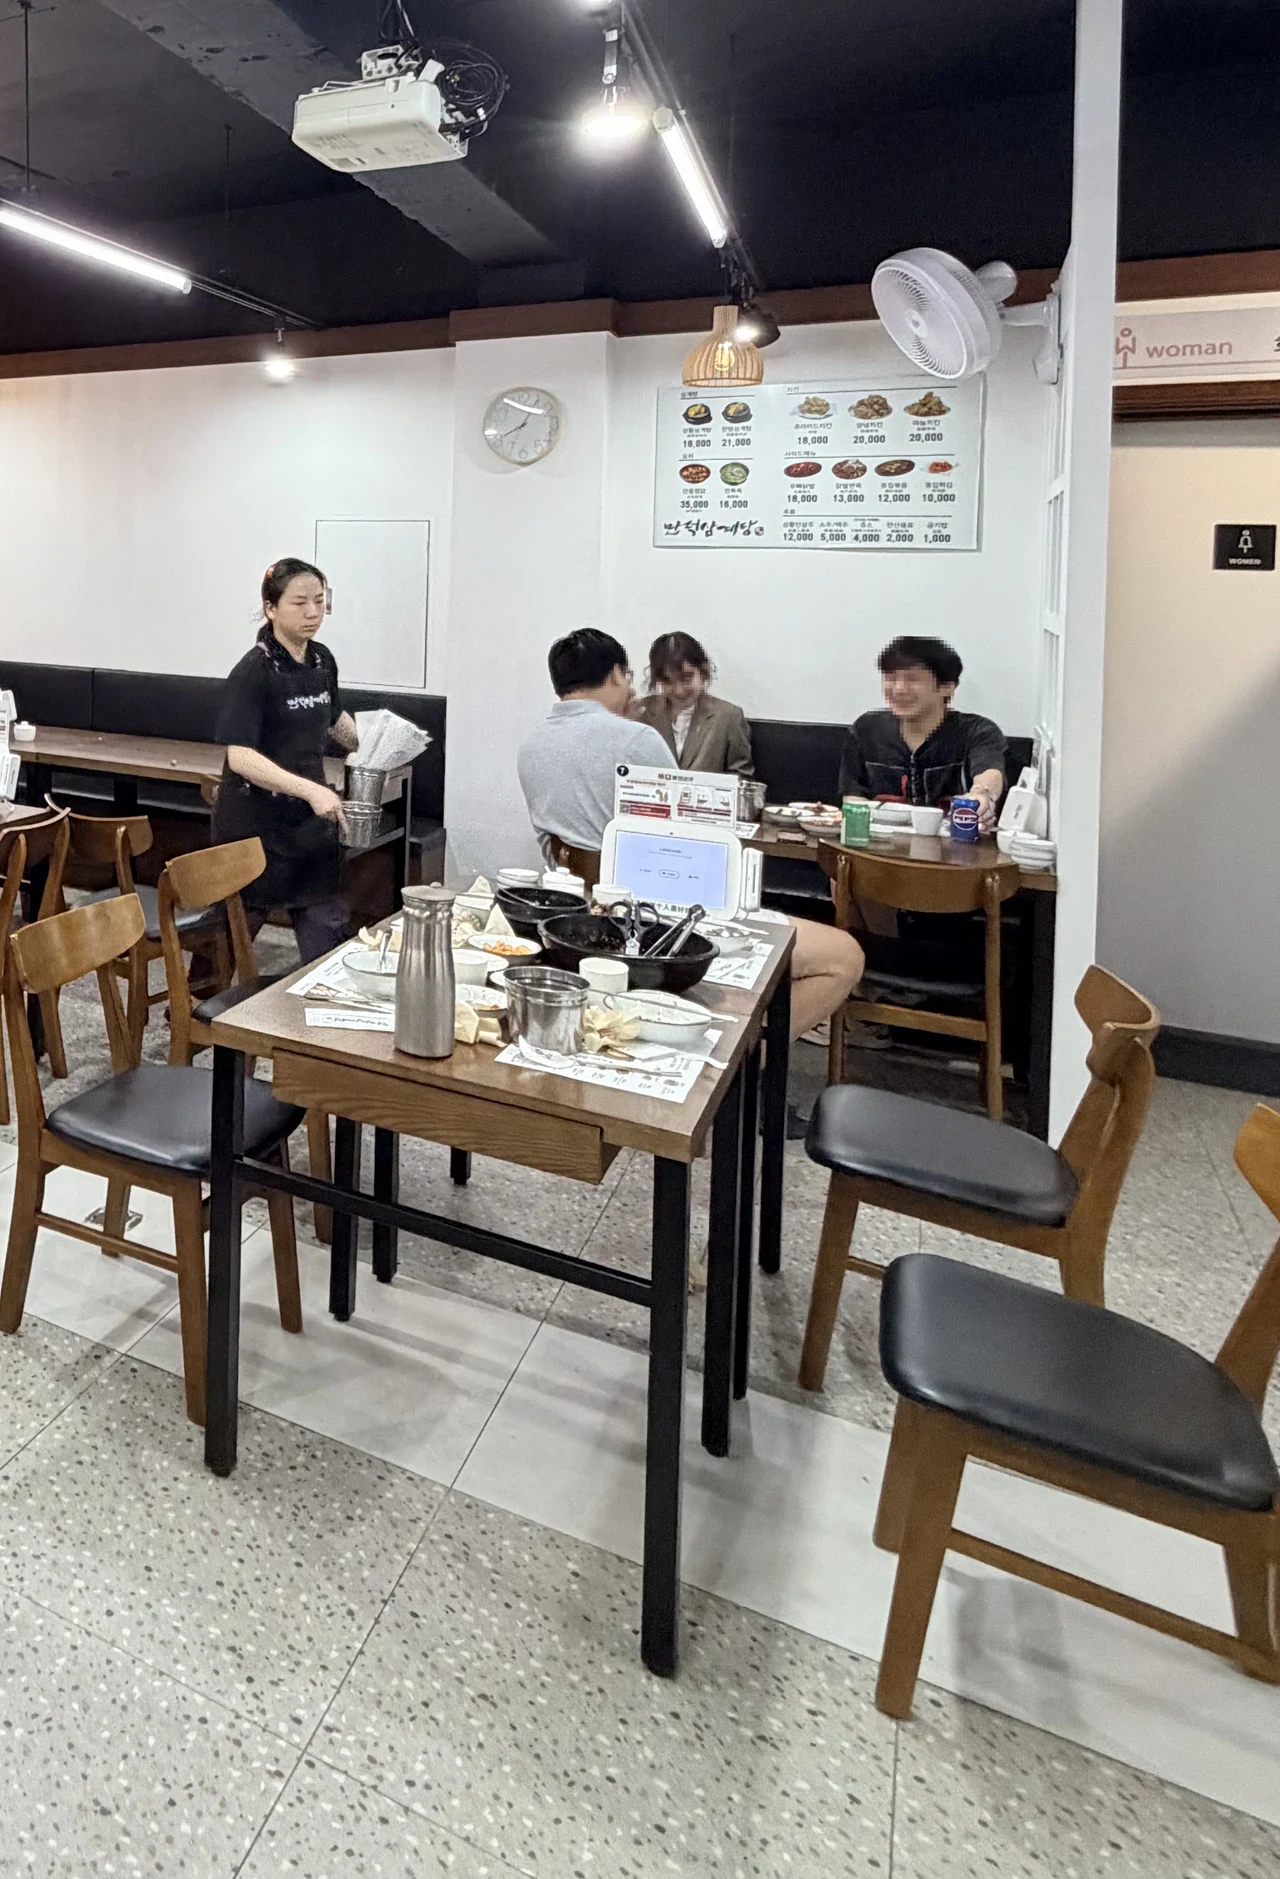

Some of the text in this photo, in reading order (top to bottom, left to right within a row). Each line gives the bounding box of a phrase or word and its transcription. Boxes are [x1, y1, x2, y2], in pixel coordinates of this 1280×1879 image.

[1145, 341, 1233, 359] woman
[721, 438, 751, 447] 21,000
[797, 436, 828, 446] 18,000
[852, 434, 886, 445] 20,000
[908, 432, 943, 443] 20,000
[683, 439, 711, 448] 18,000
[518, 444, 528, 459] 6
[833, 494, 864, 504] 13,000
[878, 494, 910, 503] 12,000
[922, 493, 956, 503] 10,000
[680, 500, 709, 509] 35,000
[783, 533, 814, 542] 12,000
[820, 533, 846, 543] 5,000
[853, 533, 880, 543] 4,000
[886, 533, 914, 543] 2,000
[923, 534, 951, 544] 1,000
[1228, 557, 1262, 565] WOMEN
